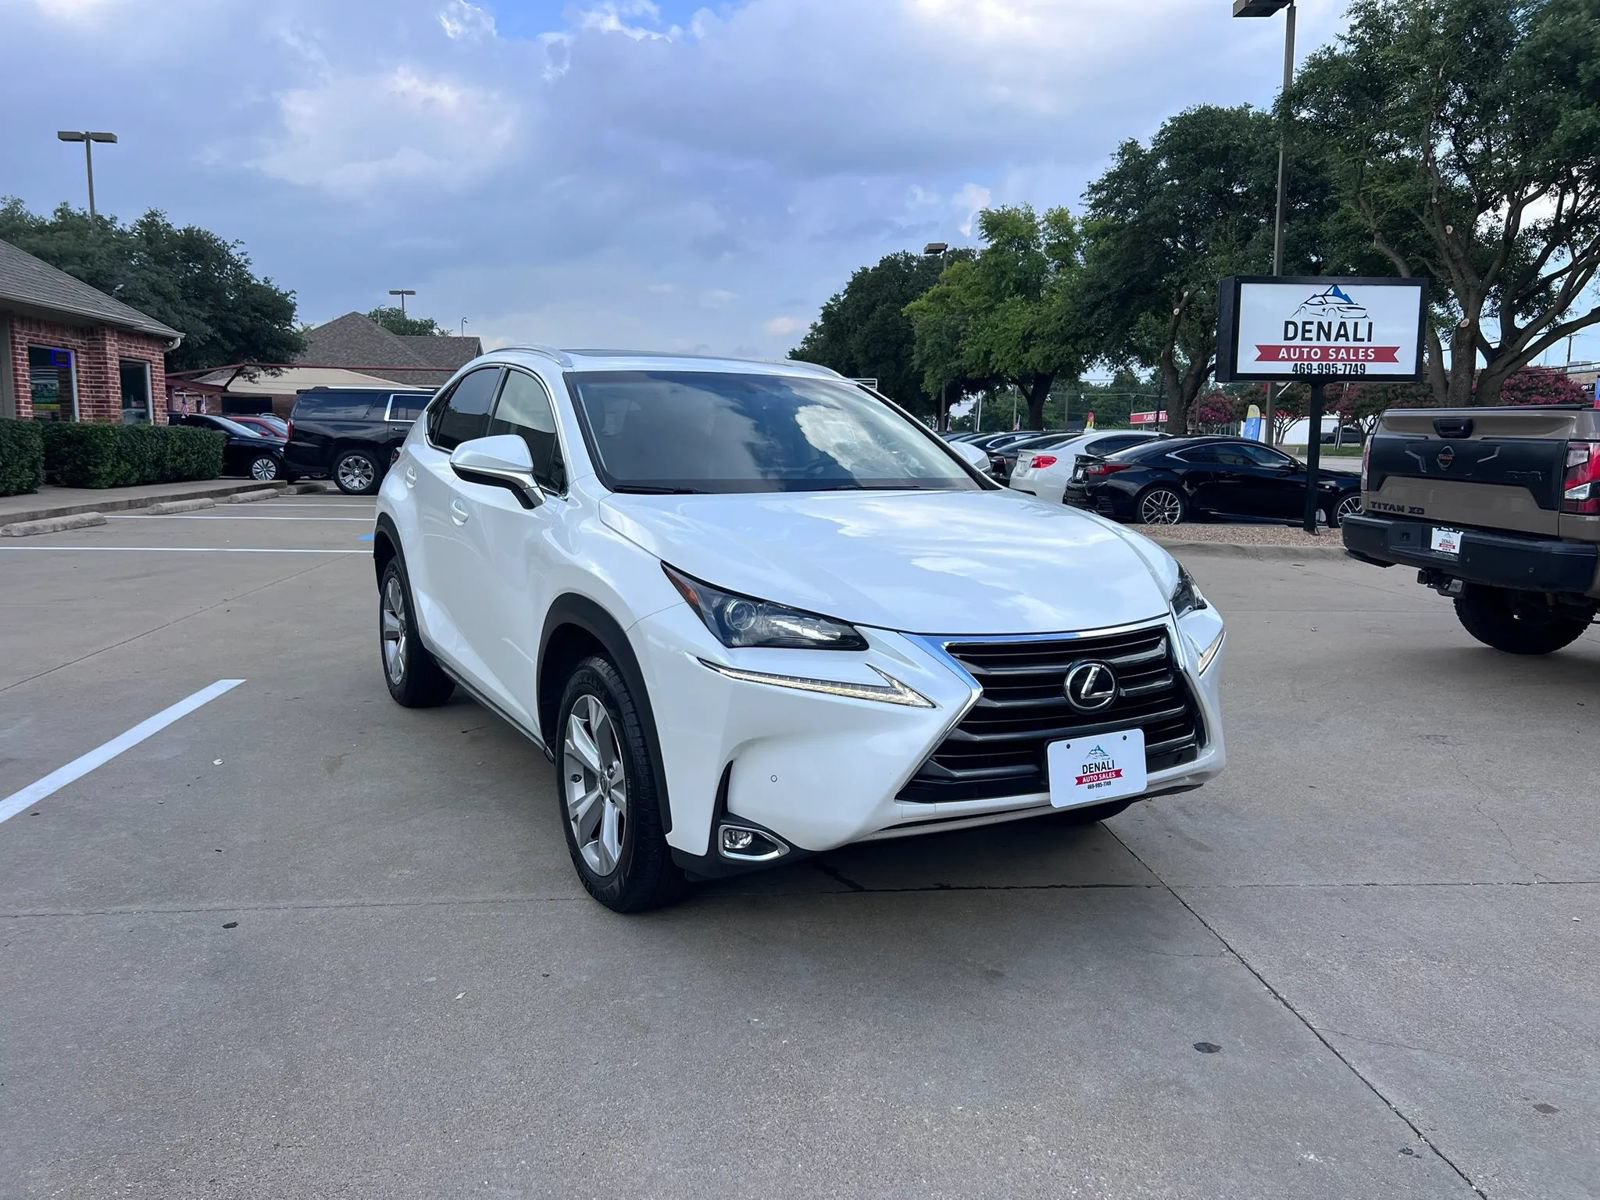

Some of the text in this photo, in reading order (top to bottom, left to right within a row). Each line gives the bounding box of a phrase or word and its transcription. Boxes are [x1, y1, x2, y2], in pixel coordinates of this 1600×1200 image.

[1283, 320, 1373, 342] DENALI
[1278, 347, 1375, 360] AUTO SALES
[1291, 363, 1366, 375] 469-995-7749
[1370, 501, 1405, 512] TITAN
[1082, 760, 1115, 775] DENALI
[1082, 771, 1117, 783] AUTO SALES
